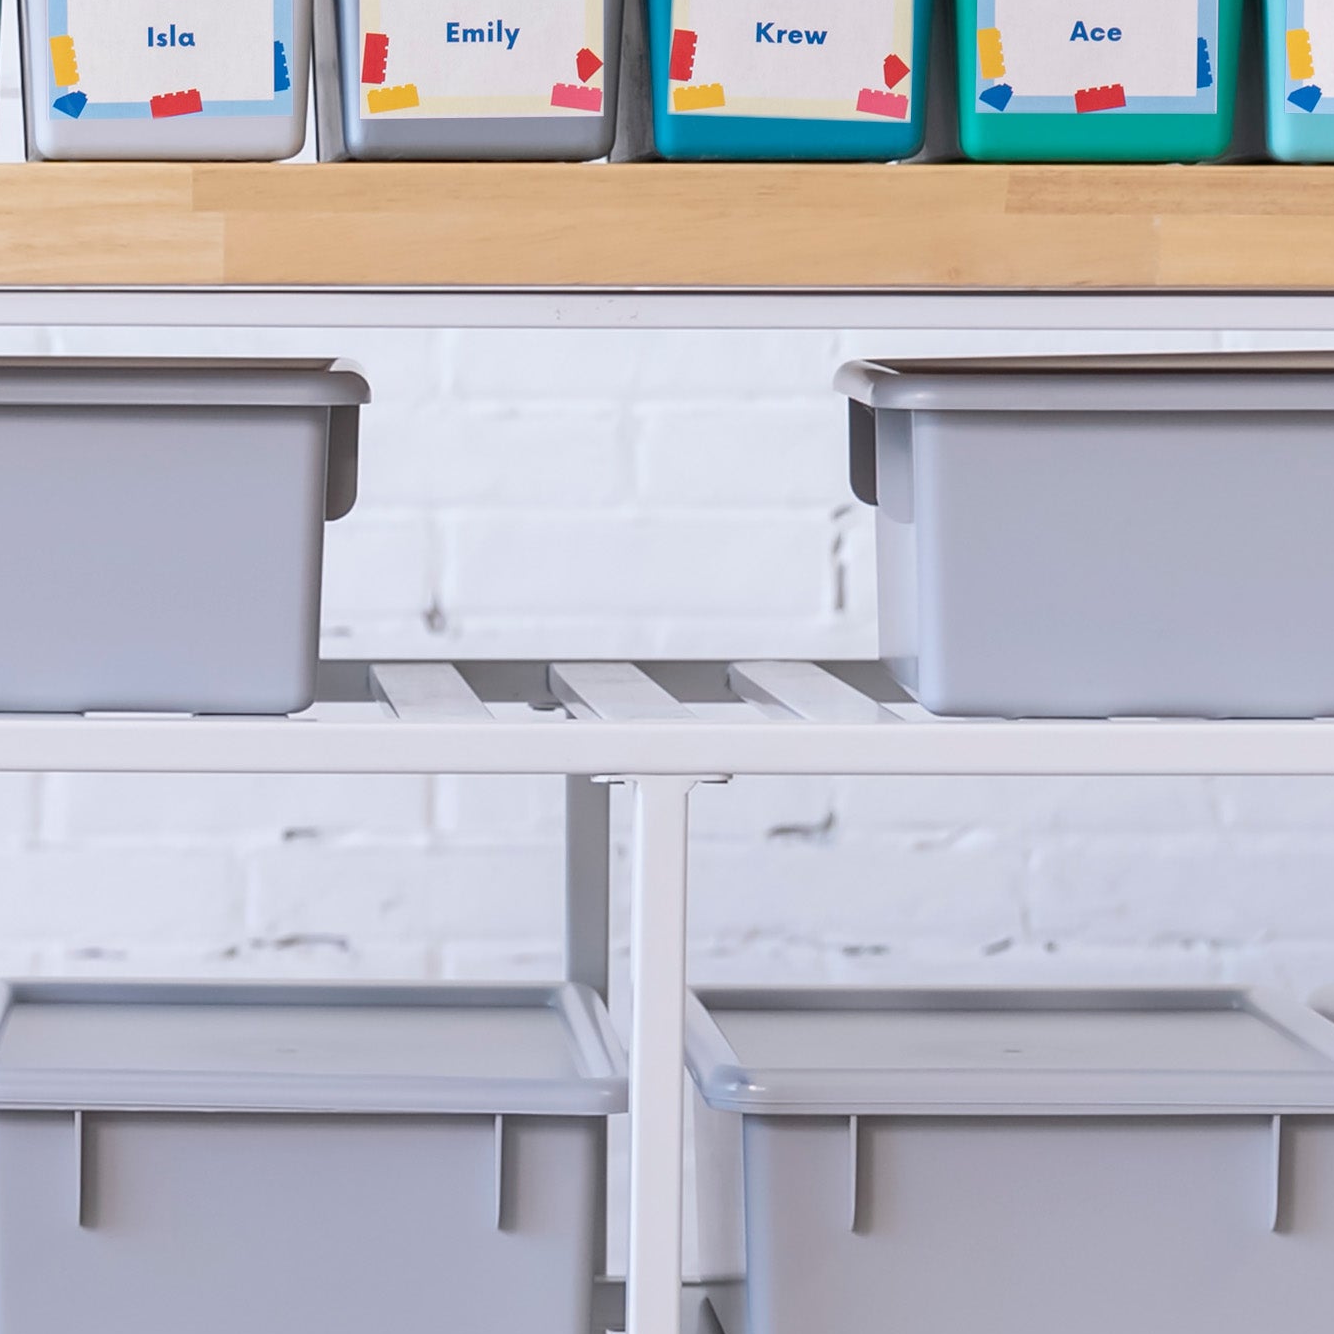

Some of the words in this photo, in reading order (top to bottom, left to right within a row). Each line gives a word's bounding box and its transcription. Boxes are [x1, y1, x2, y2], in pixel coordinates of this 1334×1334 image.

[147, 23, 196, 48] Isla
[446, 19, 521, 51] Emily
[755, 21, 828, 45] Krew
[1069, 20, 1123, 42] Ace
